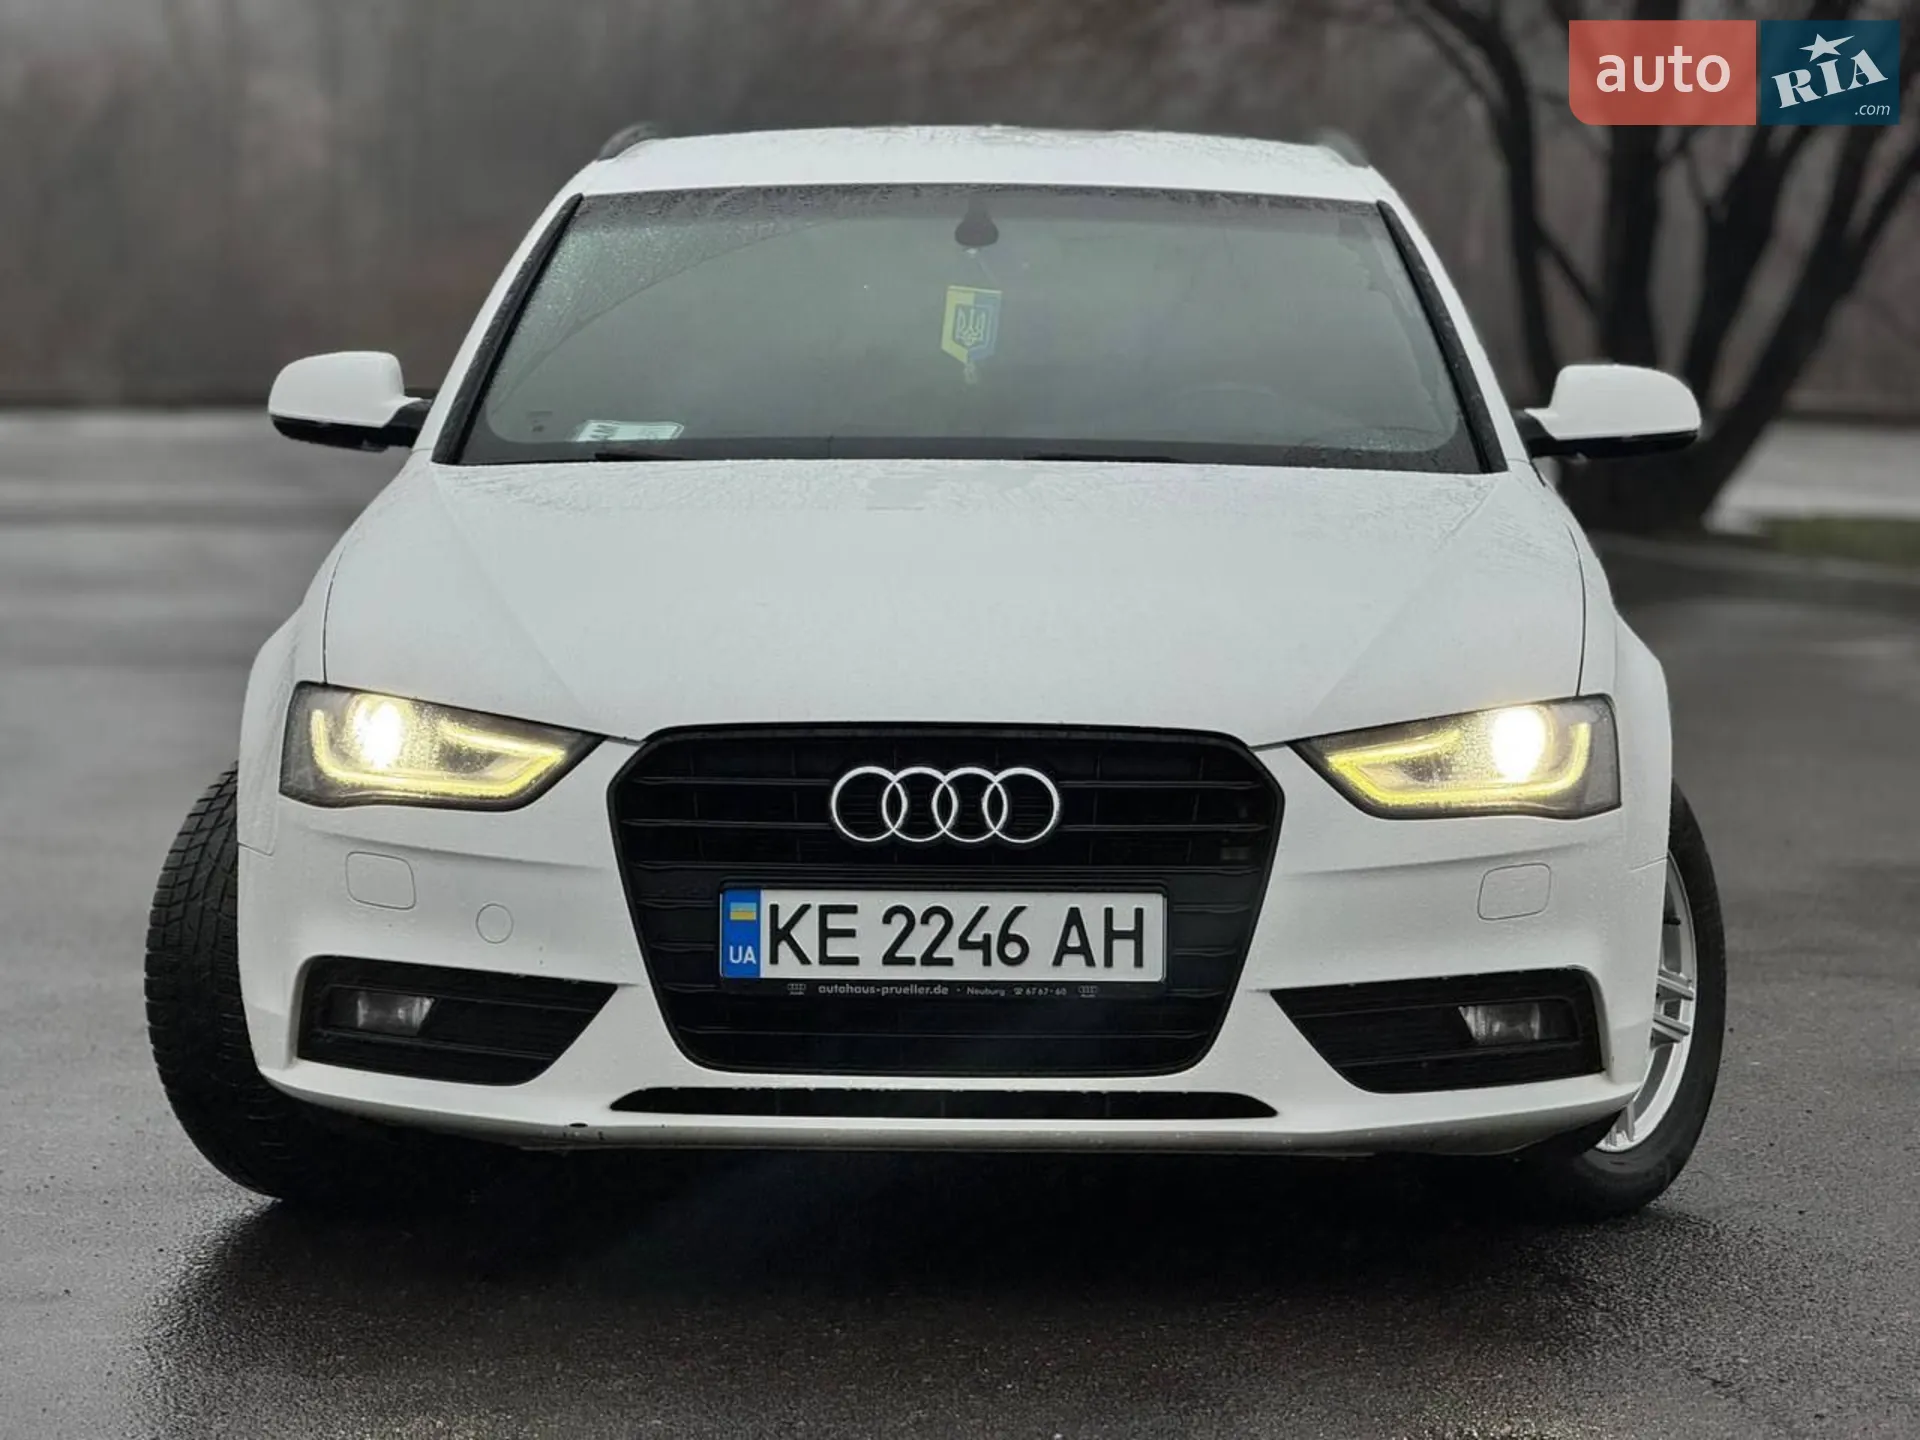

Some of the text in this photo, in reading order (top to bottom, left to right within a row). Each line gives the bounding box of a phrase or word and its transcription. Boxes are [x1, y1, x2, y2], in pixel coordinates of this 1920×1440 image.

[729, 945, 756, 964] UA
[768, 903, 1144, 968] KE 2246 AH
